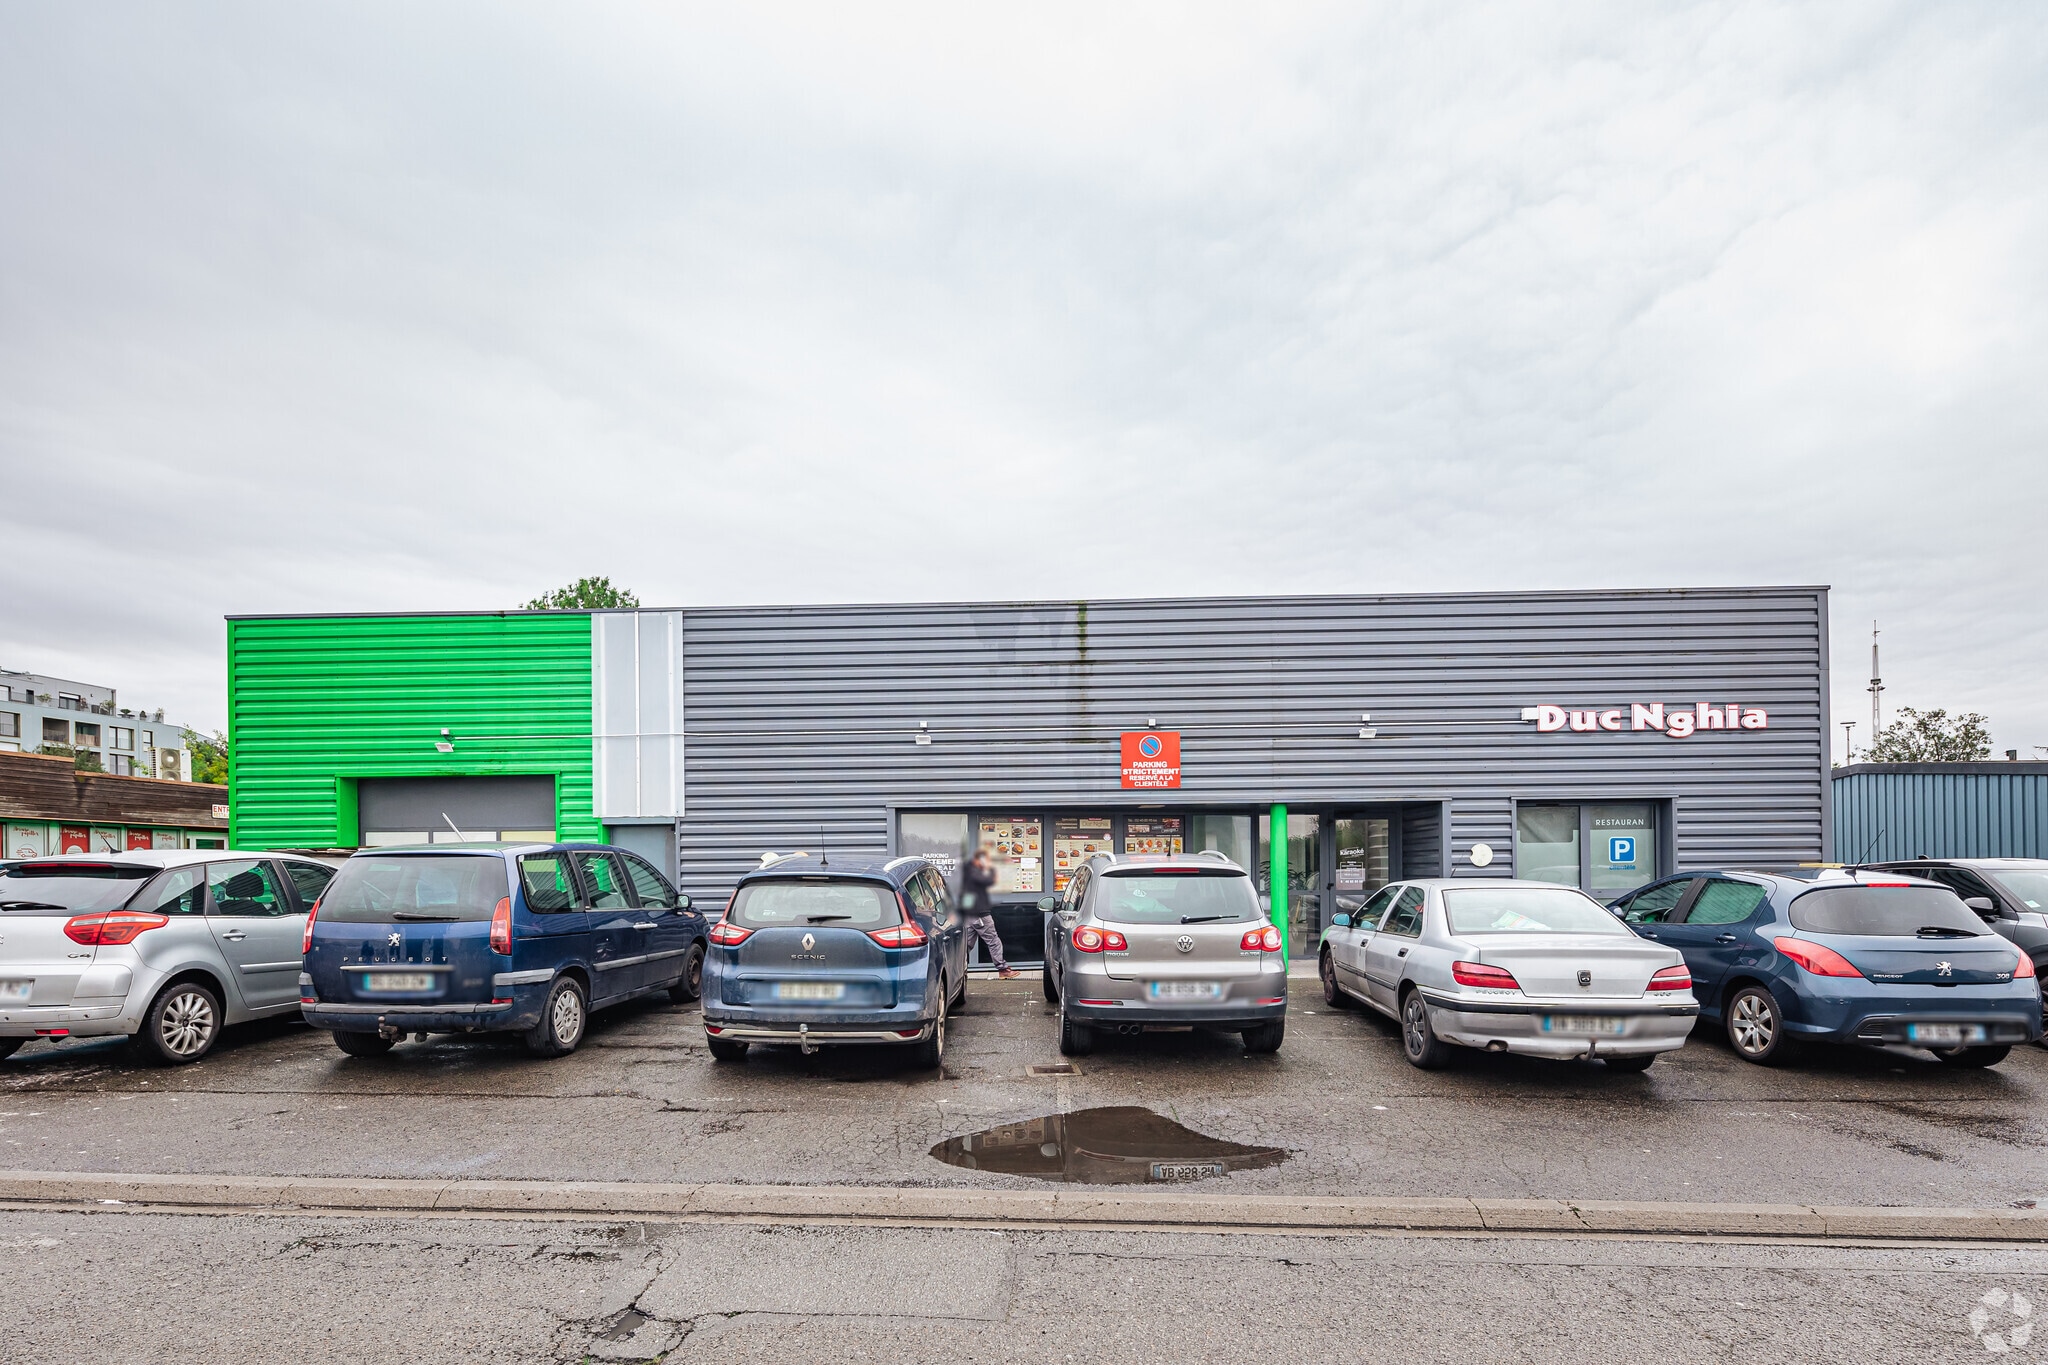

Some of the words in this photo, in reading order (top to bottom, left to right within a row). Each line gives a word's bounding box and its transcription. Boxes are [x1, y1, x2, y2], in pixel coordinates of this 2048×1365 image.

[1537, 704, 1621, 731] Duc
[1631, 702, 1767, 738] Nghia
[1614, 840, 1631, 860] P
